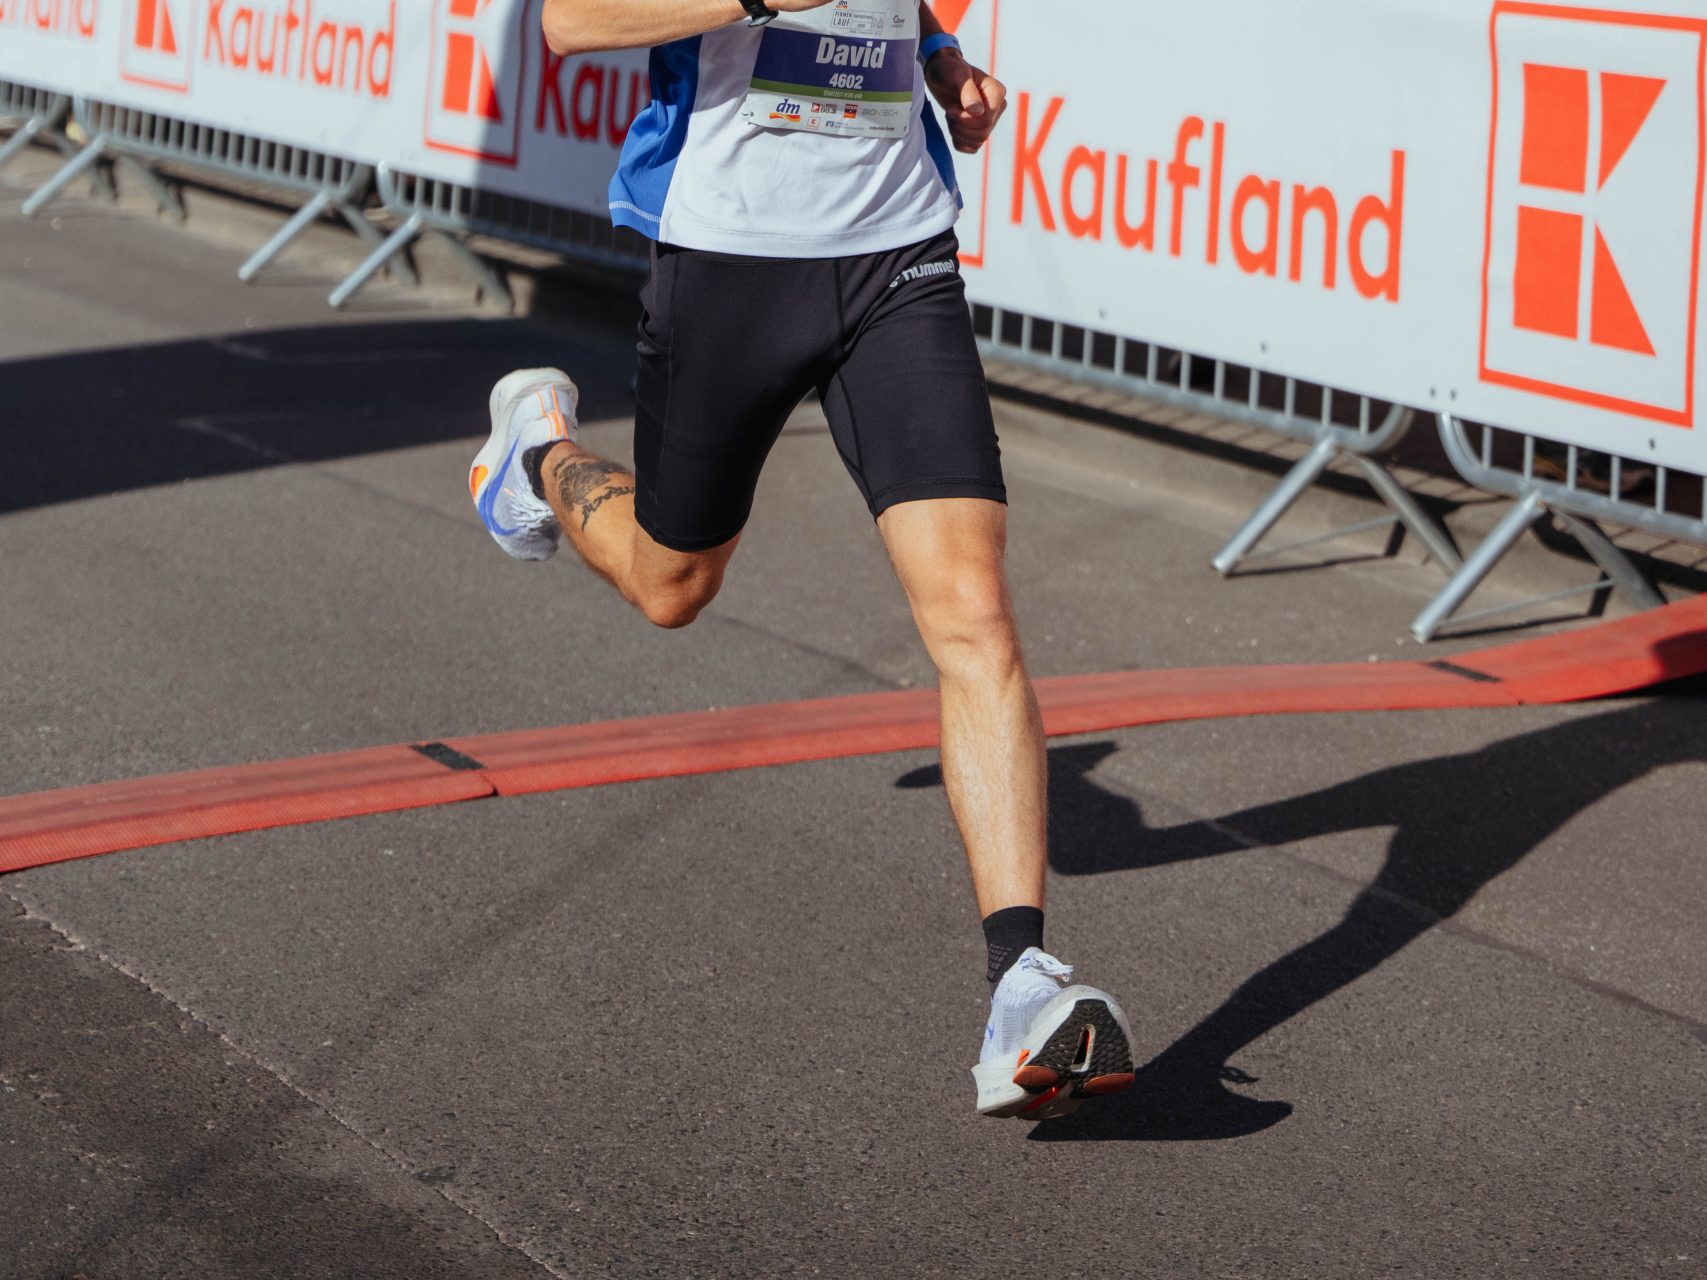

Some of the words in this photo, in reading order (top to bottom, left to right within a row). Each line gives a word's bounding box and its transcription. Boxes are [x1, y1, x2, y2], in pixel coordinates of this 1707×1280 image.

[832, 17, 851, 27] LAUF
[815, 36, 887, 69] David
[534, 31, 652, 148] Kau
[829, 73, 864, 90] 4602
[775, 98, 801, 115] dm
[1010, 90, 1405, 305] Kaufland
